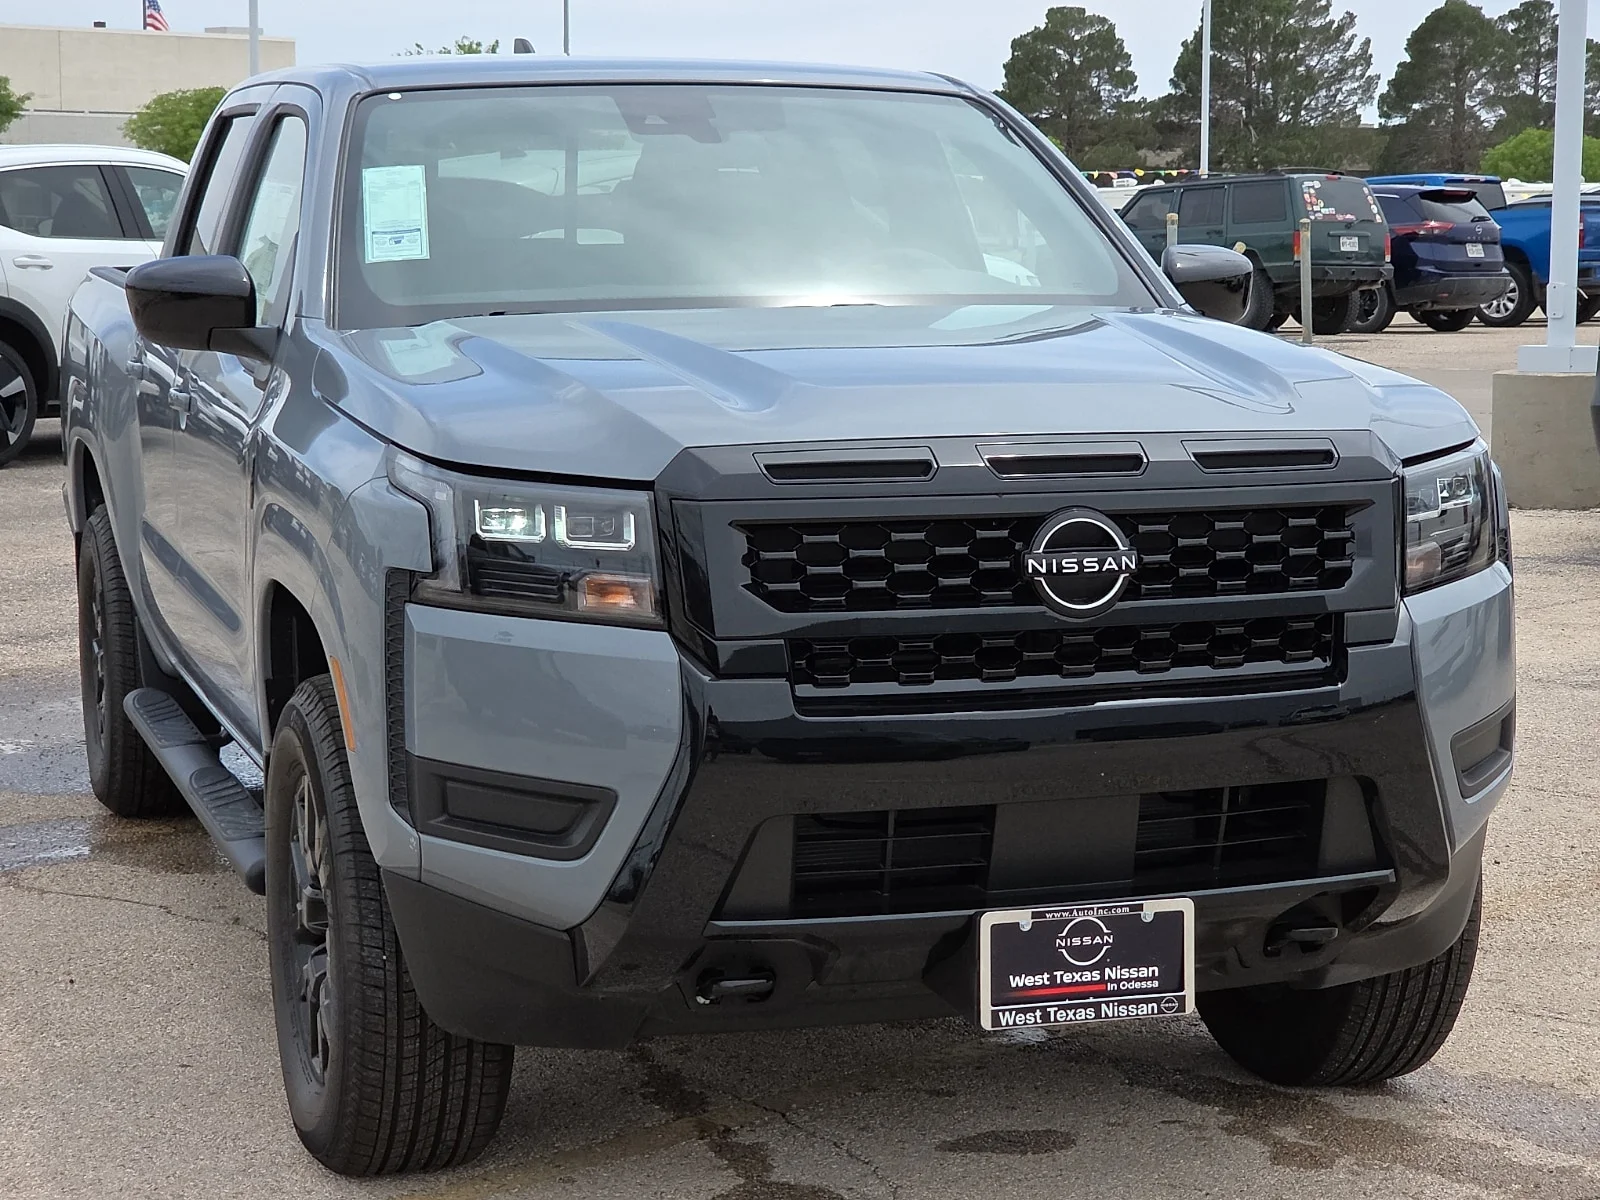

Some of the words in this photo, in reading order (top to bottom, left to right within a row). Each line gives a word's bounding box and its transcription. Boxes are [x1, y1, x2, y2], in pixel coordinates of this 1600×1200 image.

[1028, 555, 1136, 574] NISSAN
[1045, 905, 1130, 919] www.AutoInc.com
[1056, 935, 1113, 947] NISSAN
[1009, 973, 1050, 988] West
[1053, 969, 1101, 984] Texas
[1104, 965, 1159, 980] Nissan
[1107, 981, 1118, 991] In
[1119, 980, 1159, 990] Odessa
[998, 1010, 1042, 1027] West
[1046, 1006, 1096, 1021] Texas
[1101, 1001, 1158, 1018] Nissan
